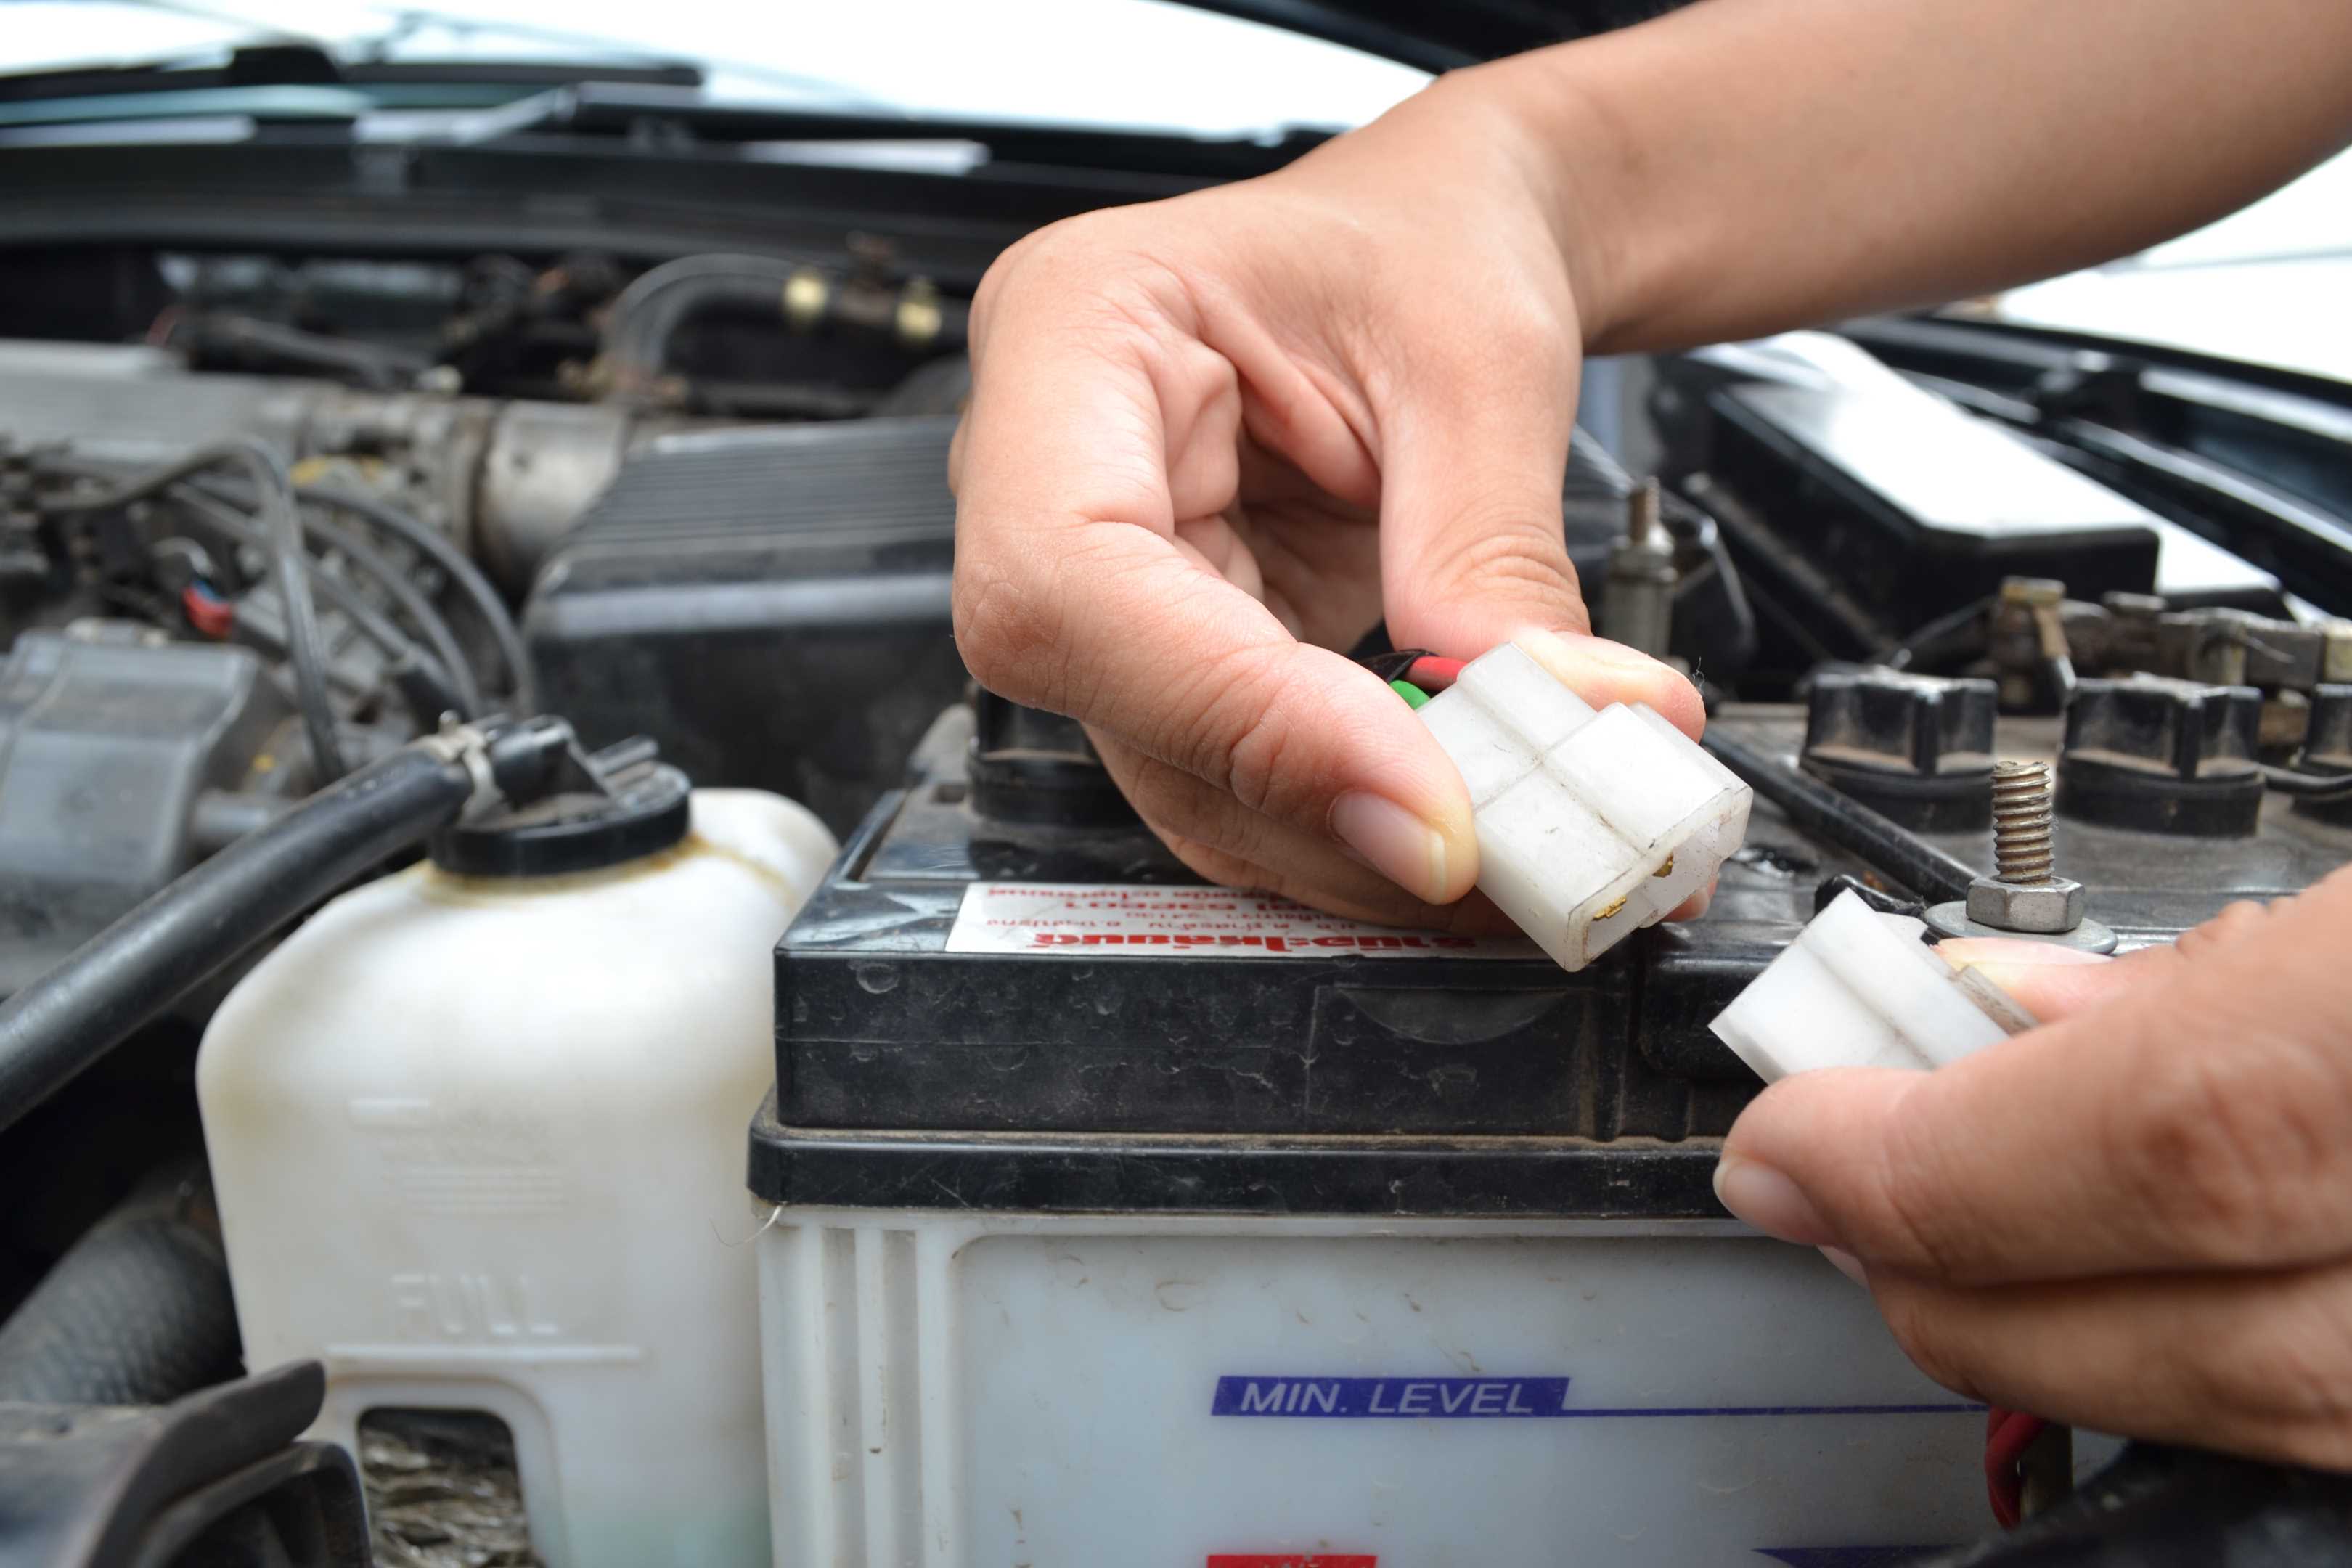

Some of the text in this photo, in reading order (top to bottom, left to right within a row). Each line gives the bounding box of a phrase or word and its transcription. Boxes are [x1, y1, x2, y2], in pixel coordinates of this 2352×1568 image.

[391, 1273, 562, 1335] FULL
[1240, 1382, 1534, 1414] MIN. LEVEL
